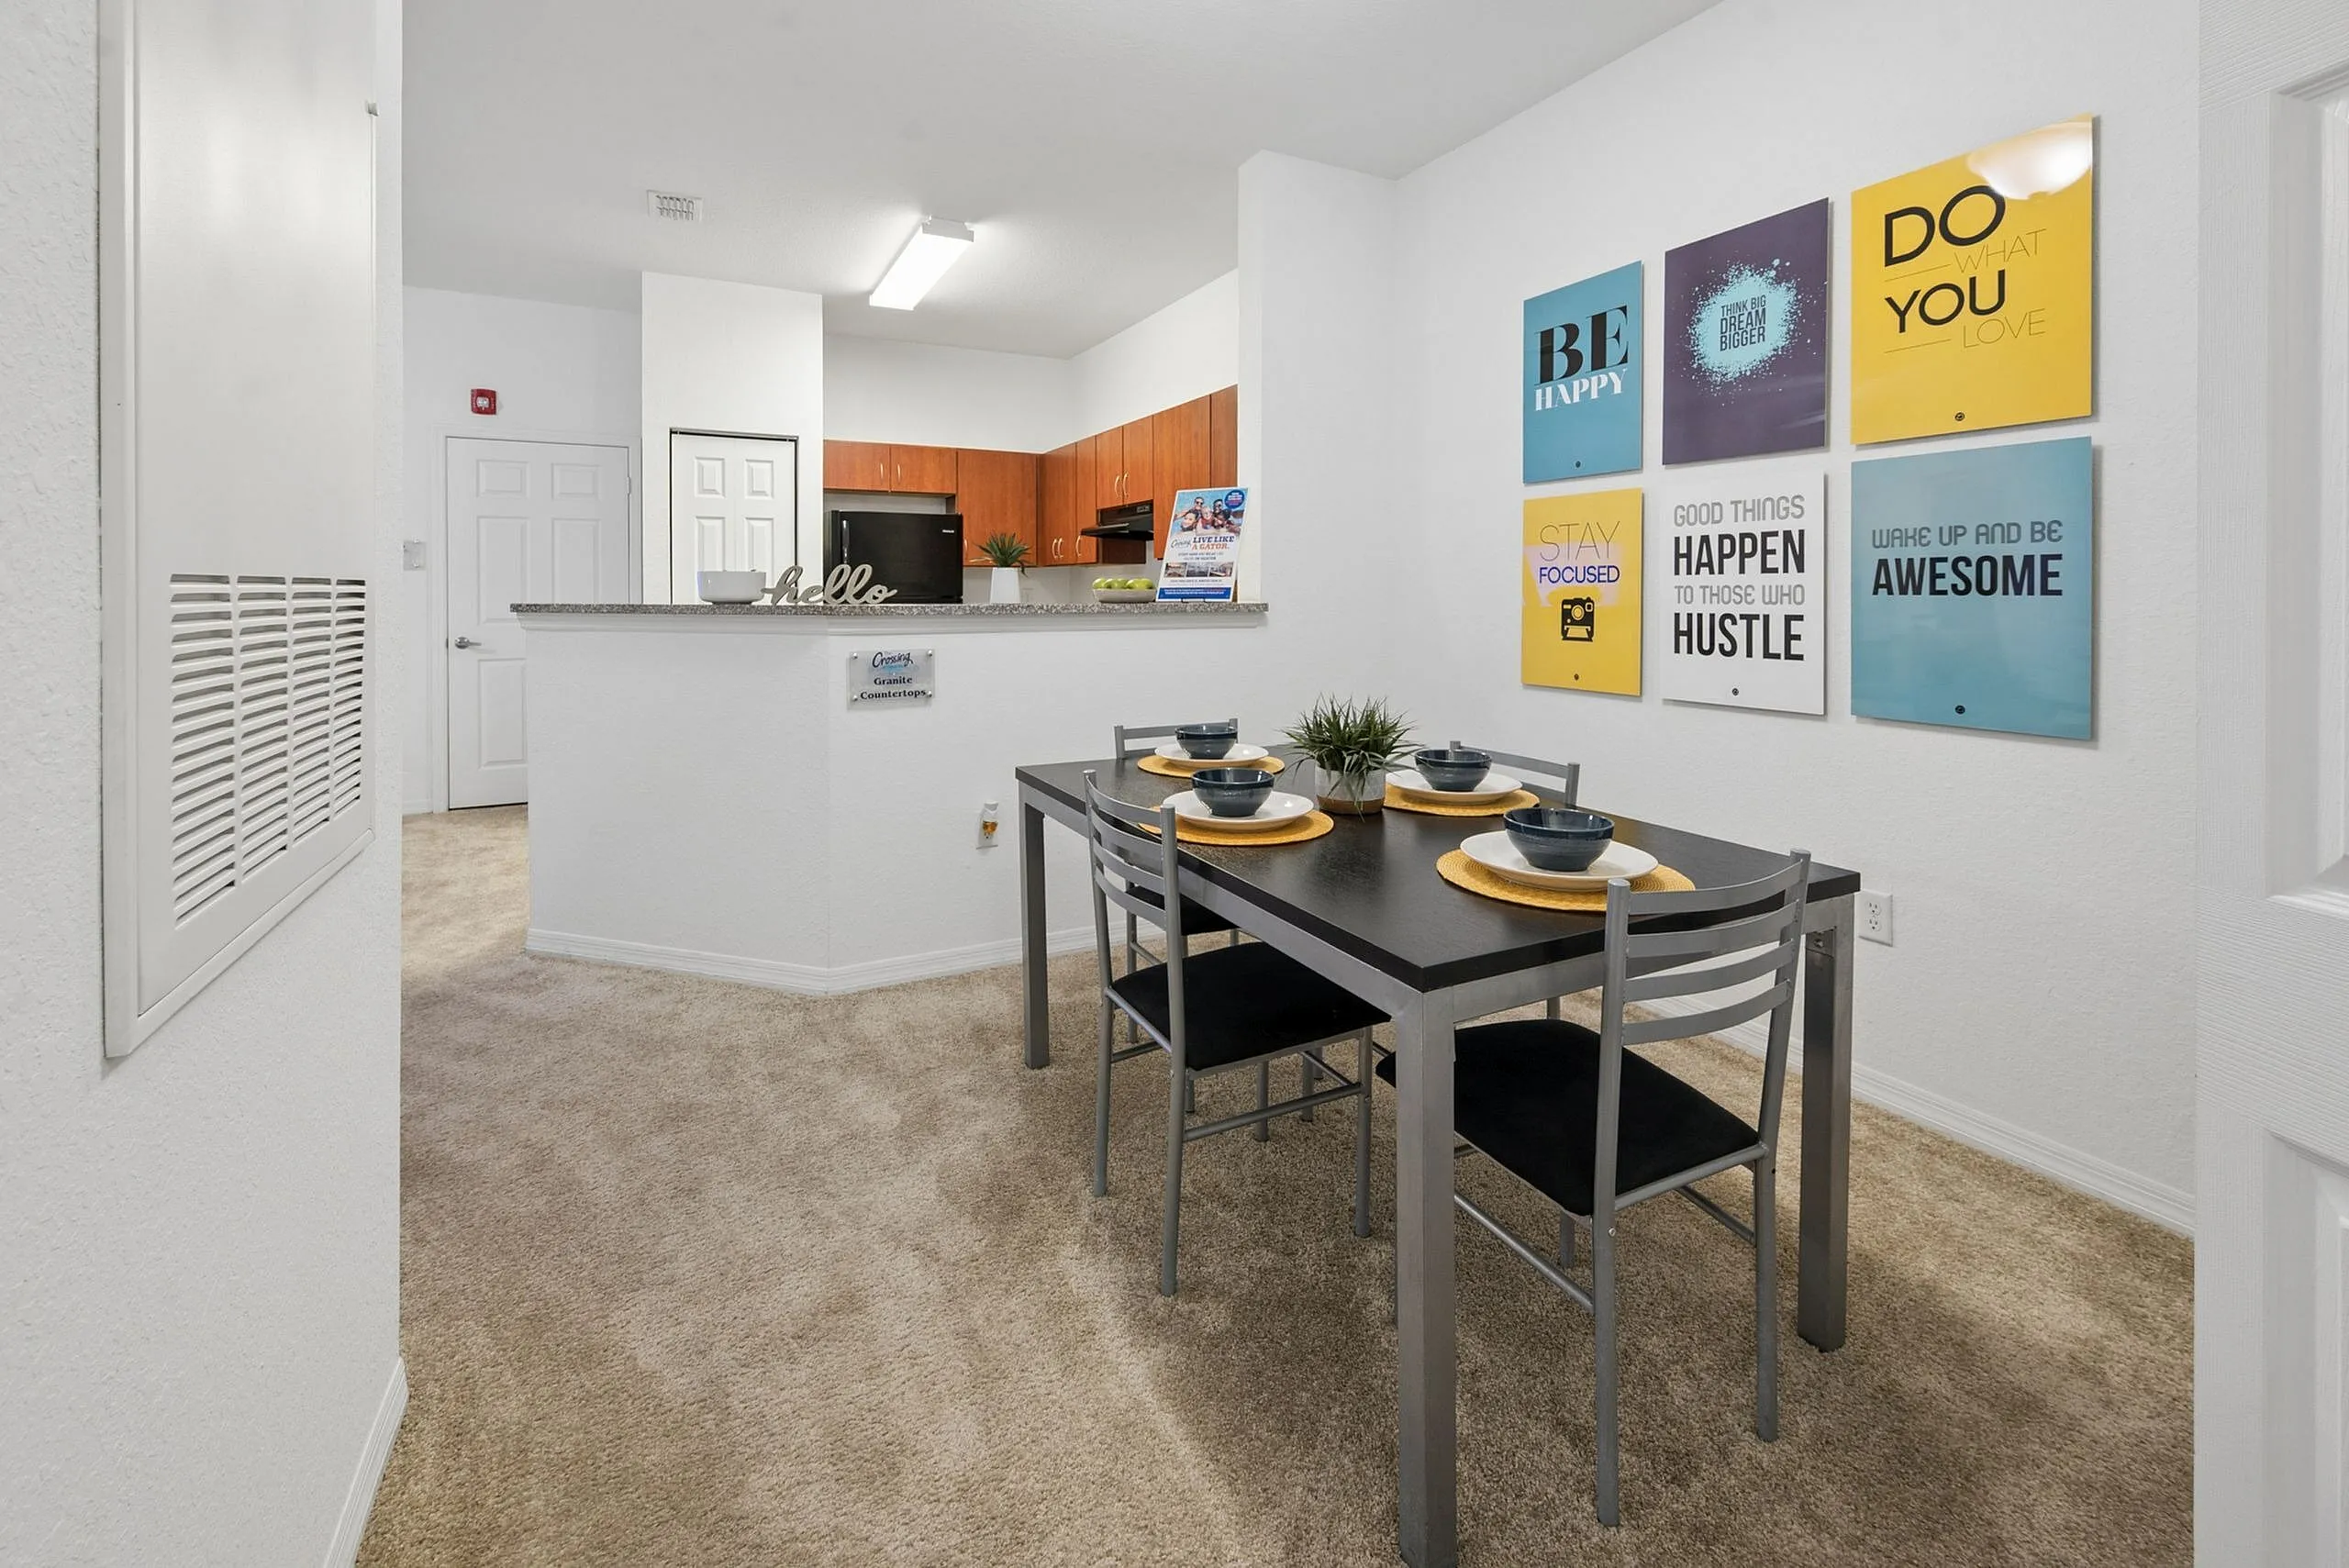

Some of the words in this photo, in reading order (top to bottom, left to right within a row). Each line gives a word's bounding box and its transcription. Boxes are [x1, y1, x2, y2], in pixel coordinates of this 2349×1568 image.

[1884, 184, 2006, 267] DO
[1954, 228, 2046, 272] WHAT
[1720, 298, 1748, 316] THINK
[1751, 295, 1766, 309] BIG
[1884, 270, 2006, 333] YOU
[1720, 307, 1766, 335] DREAM
[1963, 308, 2045, 349] LOVE
[1534, 305, 1629, 385] BE
[1720, 329, 1766, 352] BIGGER
[1533, 368, 1627, 412] HAPPY
[1674, 503, 1723, 527] GOOD
[1730, 495, 1805, 522] THINGS
[1215, 535, 1234, 543] LIKE
[1540, 521, 1620, 562] STAY
[1872, 527, 1932, 549] WAKE
[1939, 525, 1967, 546] UP
[1975, 521, 2021, 544] AND
[2031, 519, 2064, 543] BE
[1674, 529, 1805, 576] HAPPEN
[761, 564, 897, 606] hello
[1539, 565, 1620, 584] FOCUSED
[1872, 553, 2064, 596] AWESOME
[1674, 584, 1694, 605] TO
[1699, 584, 1755, 606] THOSE
[1762, 584, 1805, 606] WHO
[1674, 612, 1805, 662] HUSTLE
[872, 651, 914, 668] Crossing
[860, 688, 927, 700] Countertops
[874, 675, 913, 685] Granite
